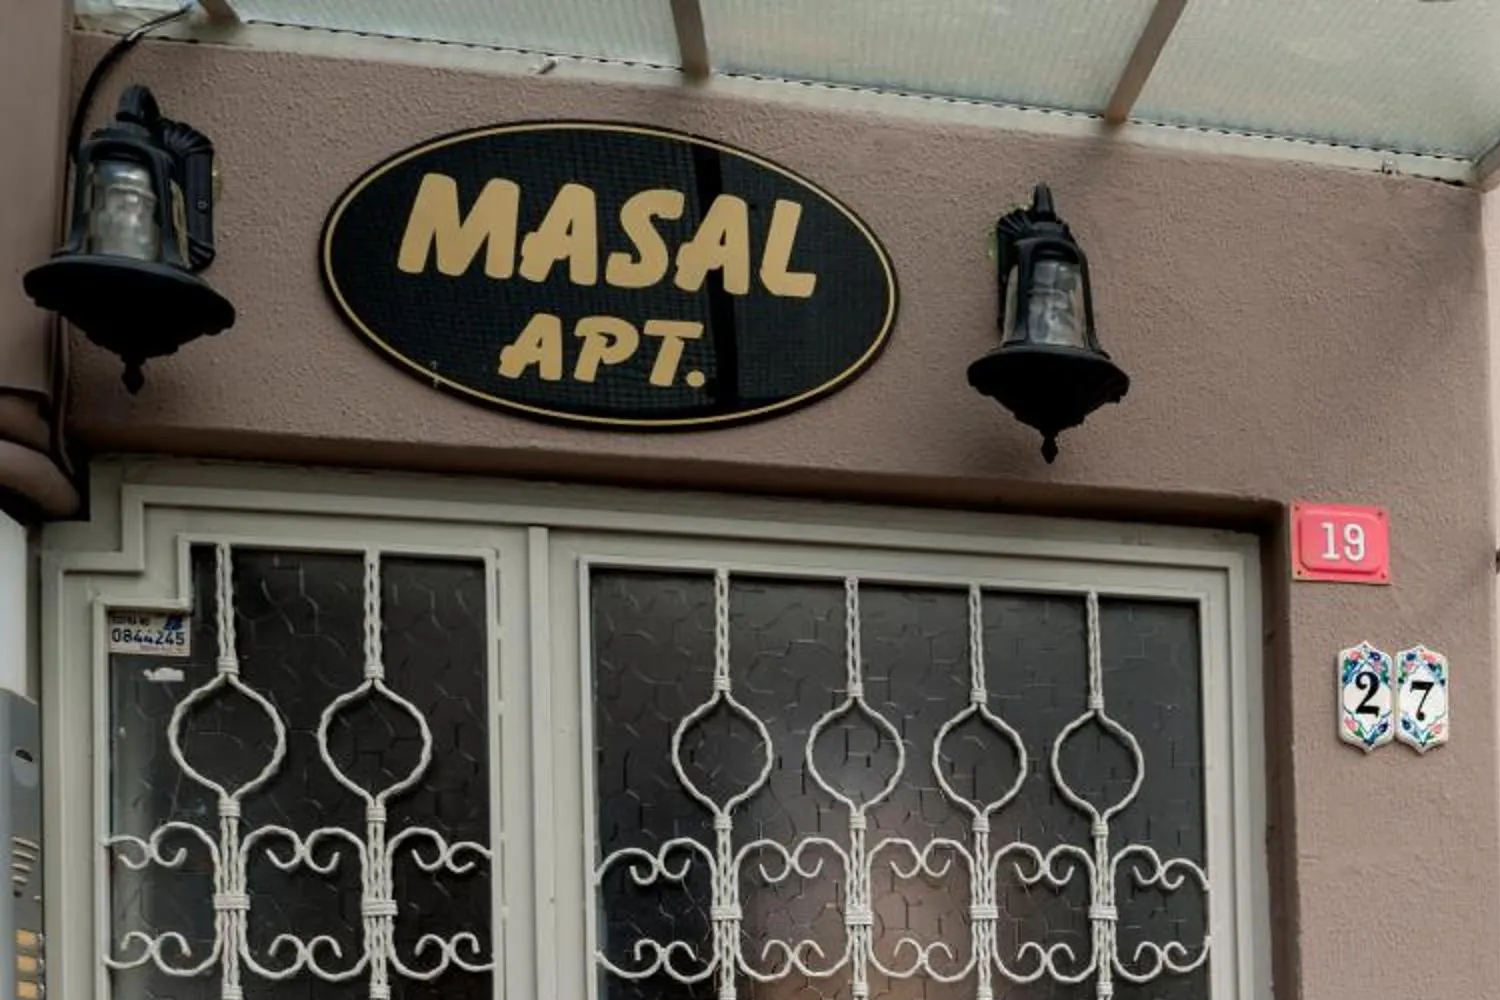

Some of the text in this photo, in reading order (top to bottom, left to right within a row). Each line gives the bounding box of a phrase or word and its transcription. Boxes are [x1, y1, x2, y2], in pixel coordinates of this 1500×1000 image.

[397, 173, 817, 299] MASAL
[499, 313, 706, 388] APT.
[1320, 521, 1366, 562] 19
